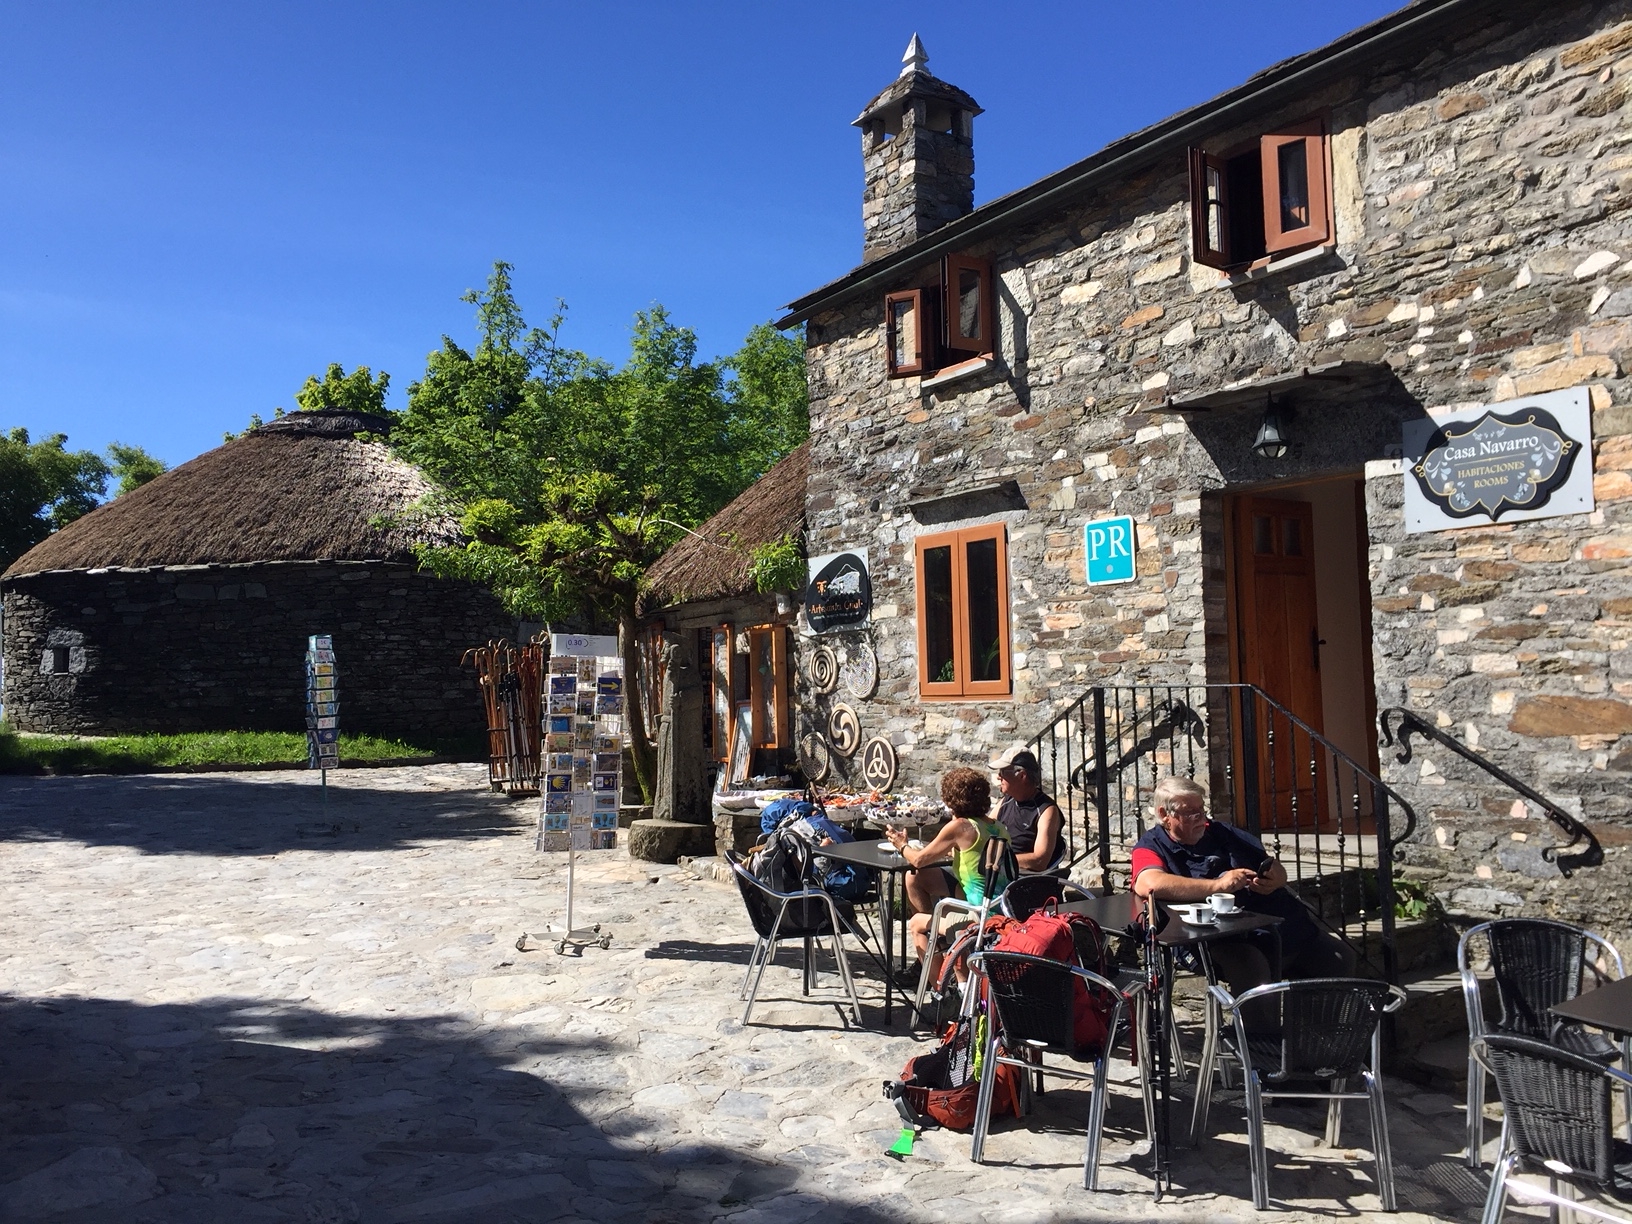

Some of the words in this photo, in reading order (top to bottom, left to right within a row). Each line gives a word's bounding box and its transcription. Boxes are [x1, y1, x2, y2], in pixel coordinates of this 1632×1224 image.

[1444, 446, 1477, 461] Casa
[1480, 436, 1539, 456] Navarro
[1457, 461, 1526, 479] HABITACIONES
[1474, 475, 1509, 489] ROOMS
[1088, 525, 1131, 561] PR
